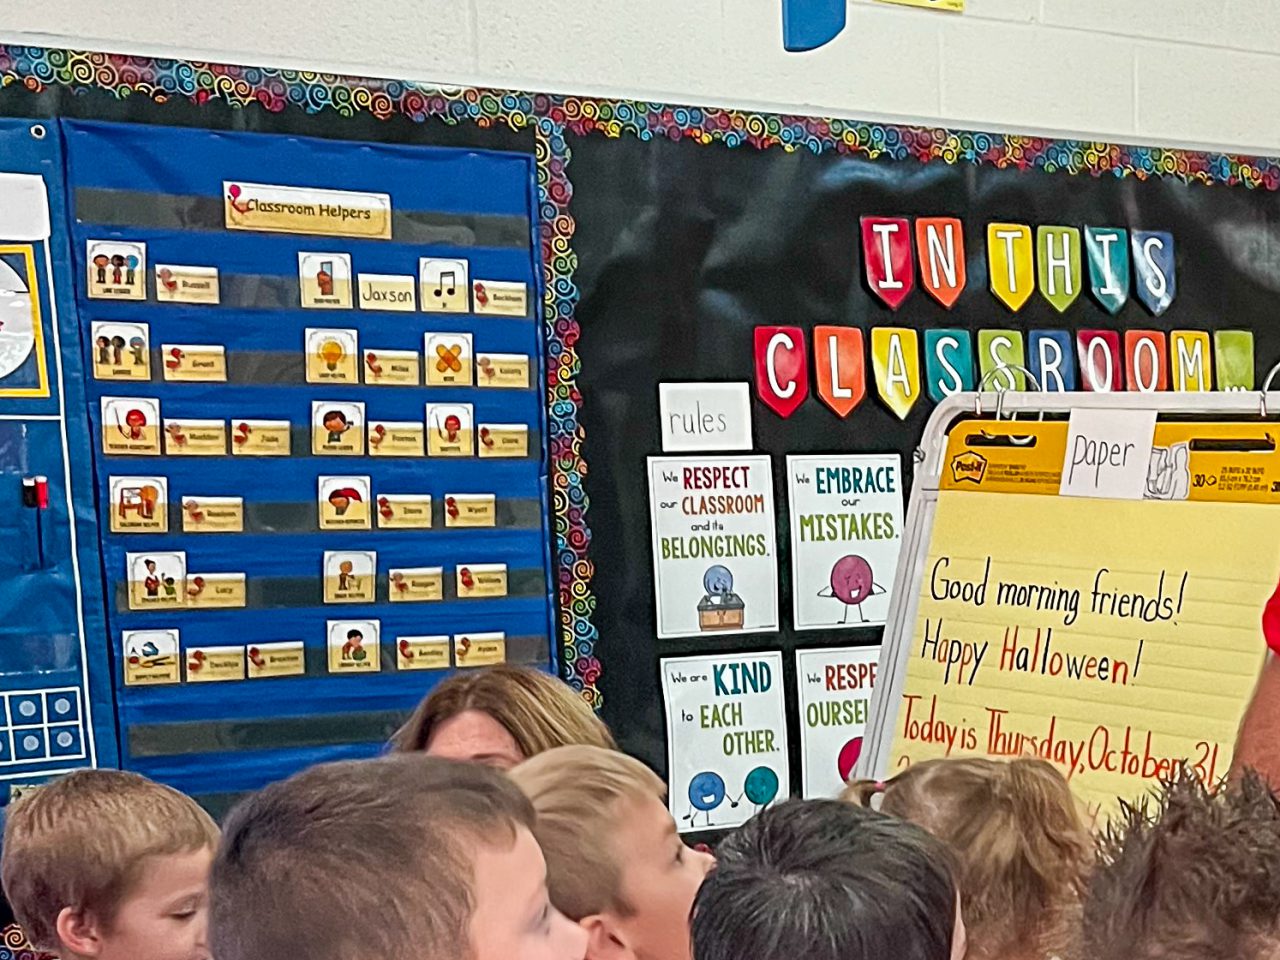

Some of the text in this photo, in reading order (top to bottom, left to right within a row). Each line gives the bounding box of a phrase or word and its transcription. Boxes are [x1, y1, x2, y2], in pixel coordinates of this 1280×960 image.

[246, 198, 371, 222] Classroom Helpers
[871, 221, 1169, 298] IN THIS
[362, 282, 412, 303] Jaxson
[668, 402, 727, 435] rules
[955, 460, 982, 472] Post-it
[1068, 434, 1135, 488] paper
[661, 465, 750, 490] We RESPECT
[795, 466, 896, 495] We EMBRACE
[659, 494, 766, 516] our CLASSROOM
[840, 497, 861, 509] our
[690, 520, 710, 533] and
[799, 512, 901, 544] MISTAKES.
[661, 533, 771, 561] BELONGINGS.
[930, 556, 1189, 628] Good morning friends!
[920, 618, 1145, 687] Happy Halloween!
[670, 660, 773, 697] We are KIND
[806, 672, 823, 684] We
[681, 703, 744, 729] to EACH
[902, 694, 957, 756] Today
[960, 718, 978, 750] is
[722, 729, 781, 757] OTHER.
